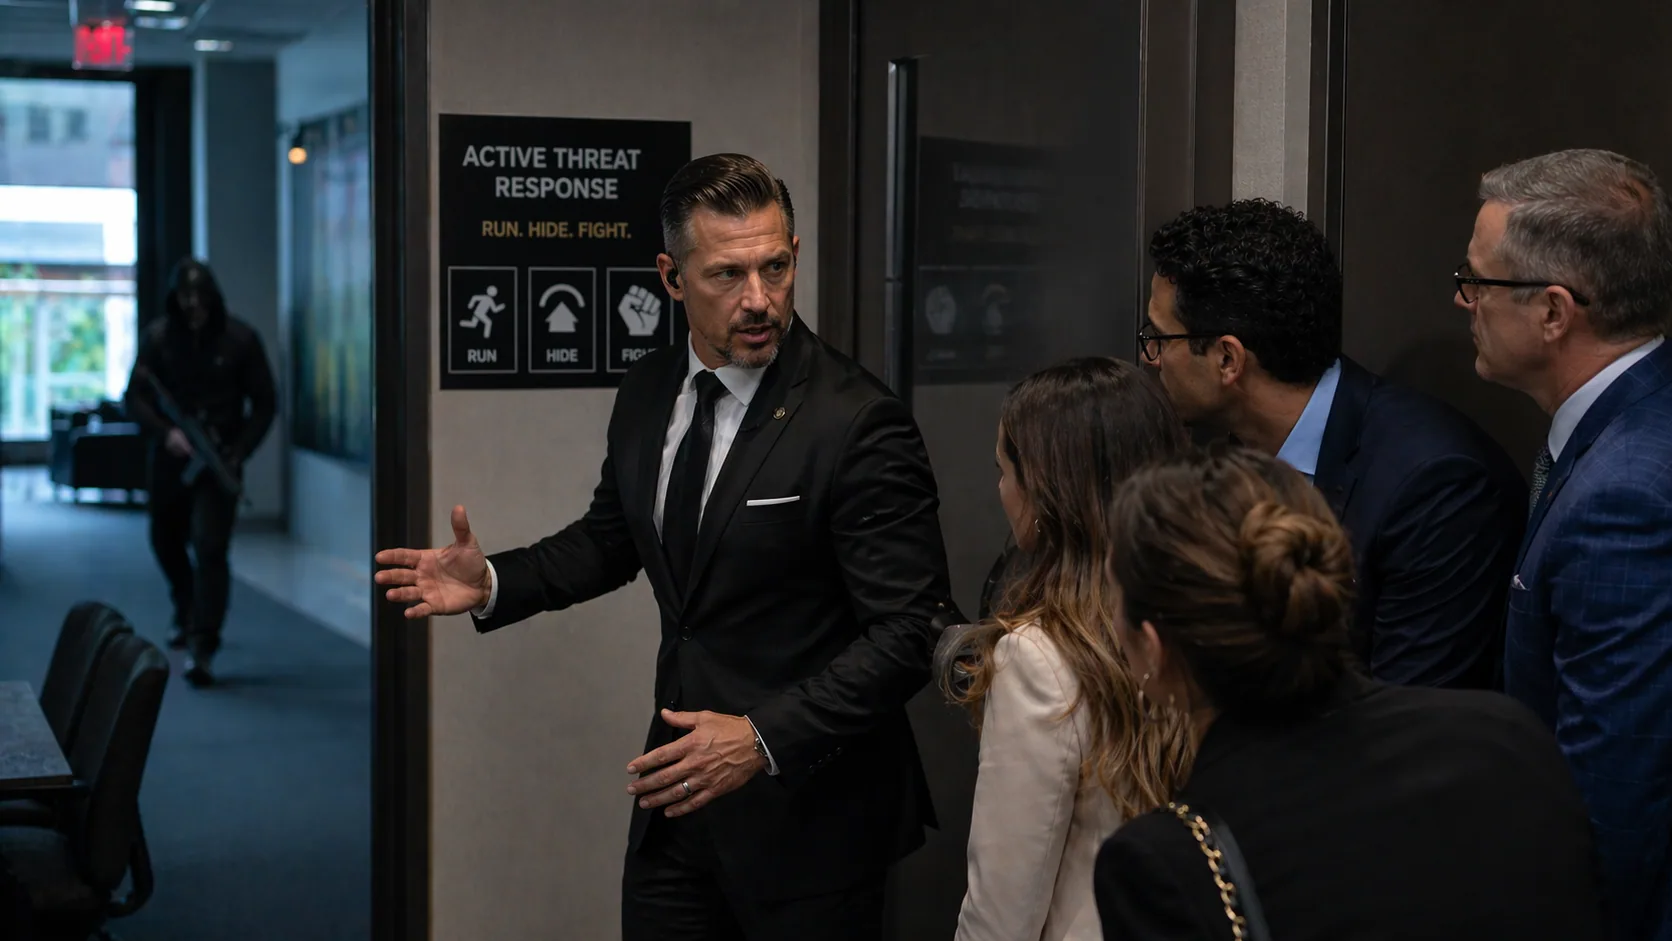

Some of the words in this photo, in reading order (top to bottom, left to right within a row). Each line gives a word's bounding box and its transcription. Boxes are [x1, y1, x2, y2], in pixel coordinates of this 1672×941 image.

[462, 145, 547, 169] ACTIVE
[553, 147, 641, 170] THREAT
[495, 176, 619, 200] RESPONSE
[481, 220, 523, 238] RUN.
[528, 221, 573, 239] HIDE.
[578, 222, 632, 239] FIGHT.
[467, 349, 497, 363] RUN
[546, 349, 578, 363] HIDE
